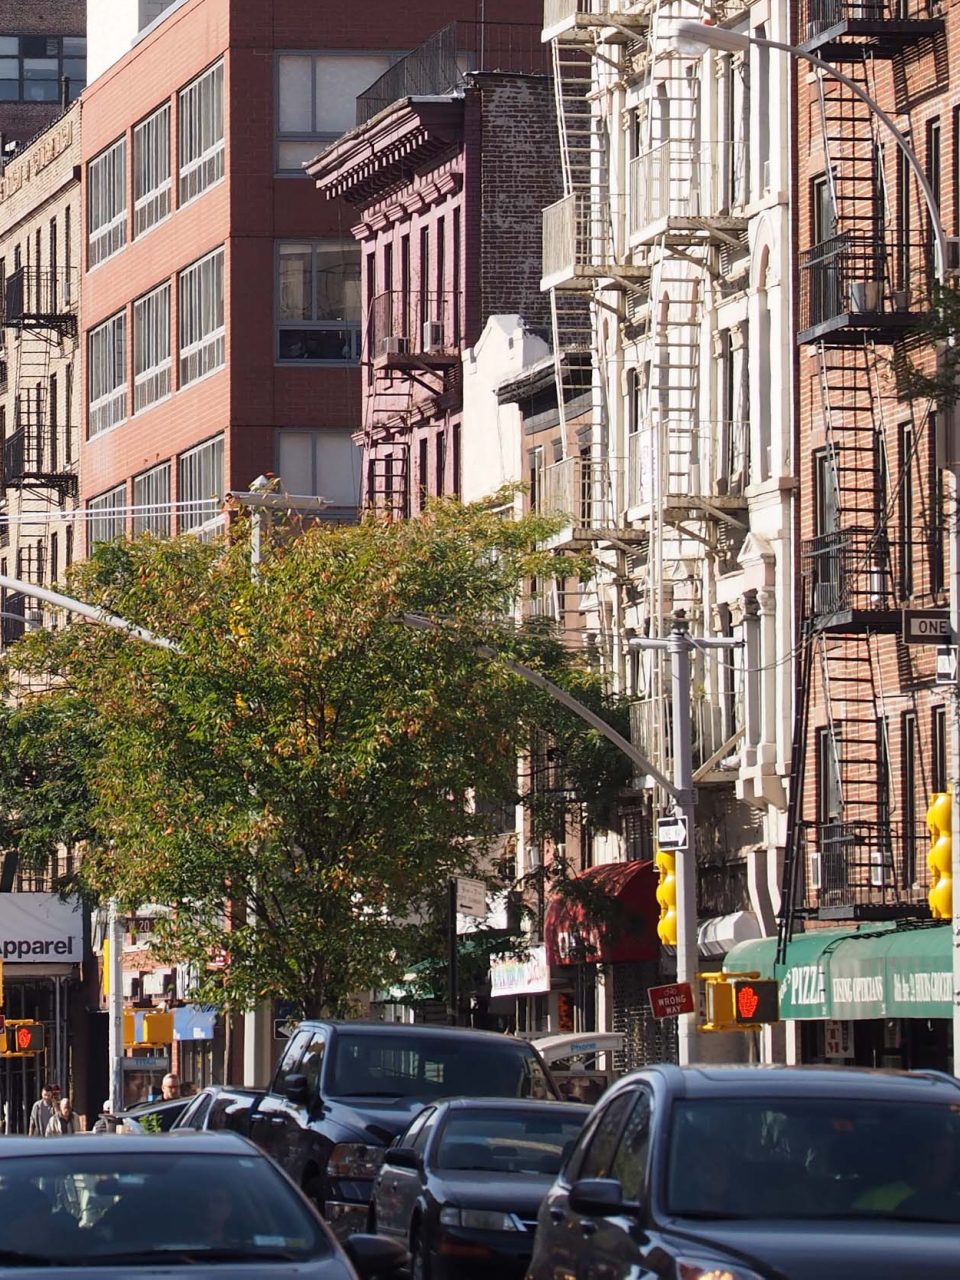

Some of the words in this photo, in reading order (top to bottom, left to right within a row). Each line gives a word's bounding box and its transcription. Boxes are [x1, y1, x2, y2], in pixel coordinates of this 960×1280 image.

[918, 620, 947, 634] ONE
[139, 919, 150, 932] 20
[790, 965, 825, 1005] PIZZA
[658, 994, 687, 1007] WRONG
[665, 1005, 682, 1015] WAY
[570, 1042, 596, 1053] Phone
